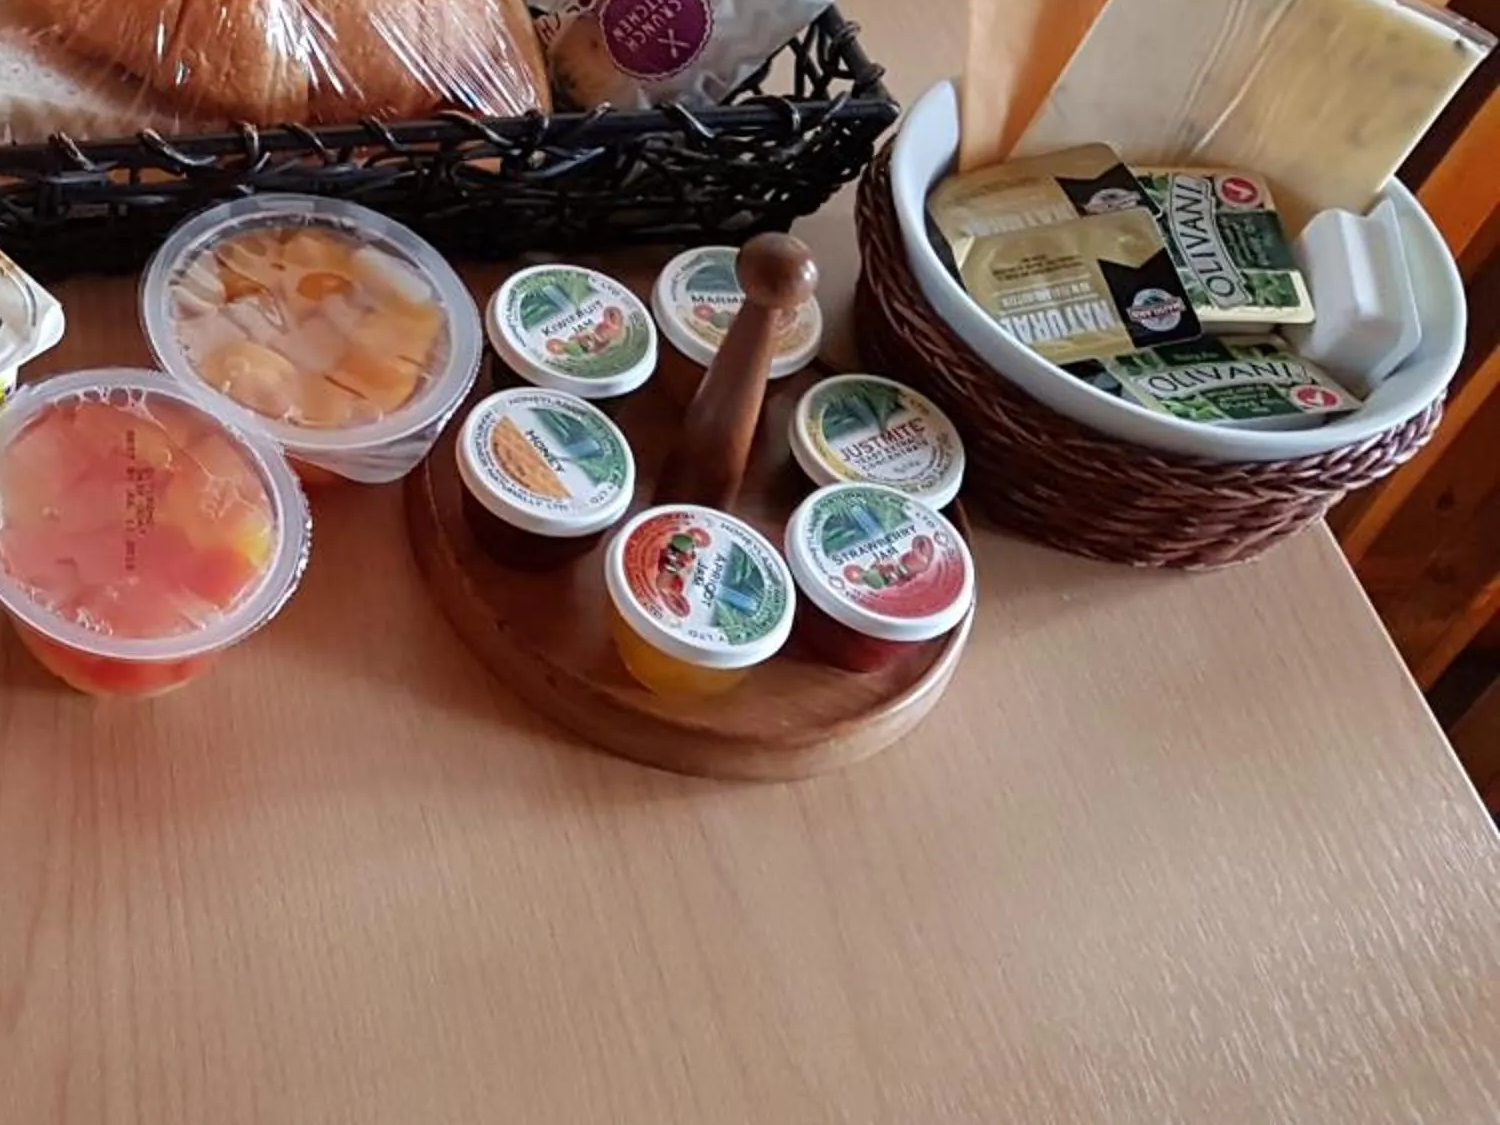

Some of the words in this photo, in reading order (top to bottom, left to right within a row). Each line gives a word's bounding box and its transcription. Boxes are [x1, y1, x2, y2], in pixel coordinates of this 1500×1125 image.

[1175, 177, 1236, 298] OLIVANI
[1147, 360, 1296, 395] OLIVANI
[525, 428, 565, 473] HONEY
[839, 416, 925, 463] JUSTMITE
[831, 524, 918, 565] STRAWBERRY
[871, 546, 900, 562] JAM
[700, 552, 727, 609] APRICOT
